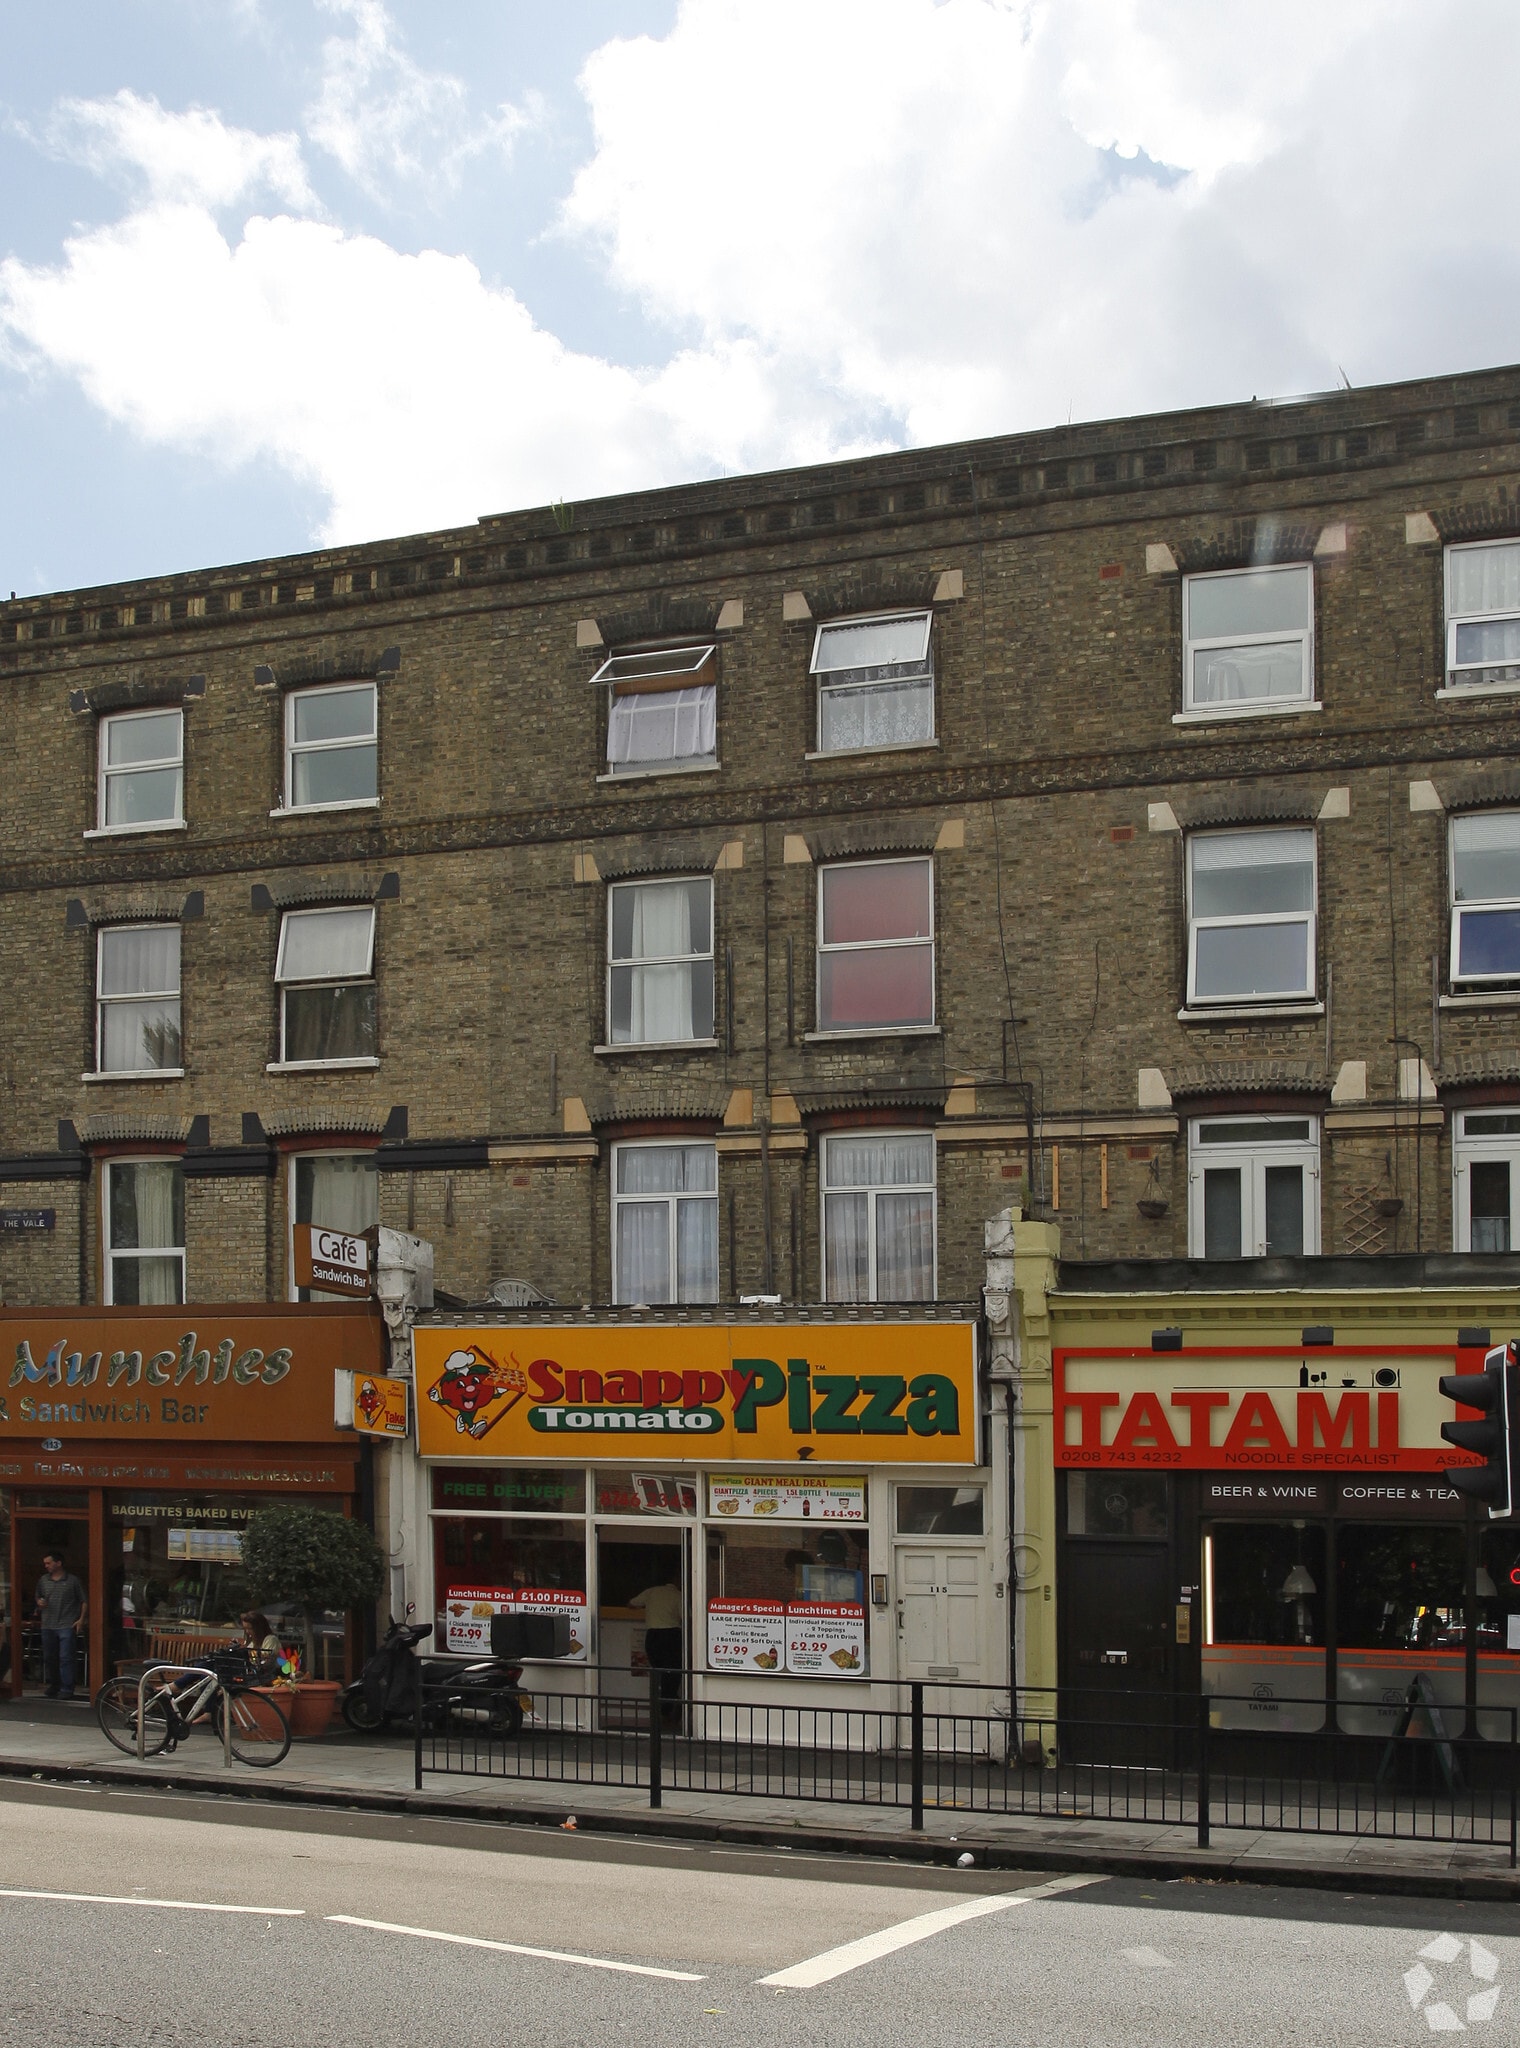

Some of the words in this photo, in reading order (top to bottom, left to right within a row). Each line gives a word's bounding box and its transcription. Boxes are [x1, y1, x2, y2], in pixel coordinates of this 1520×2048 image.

[23, 1219, 45, 1227] VALE
[319, 1233, 357, 1264] Café
[313, 1265, 352, 1285] Sandwich
[353, 1274, 367, 1288] Bar
[8, 1331, 294, 1388] Munchies
[528, 1359, 754, 1411] Snappy
[732, 1359, 961, 1437] Pizza
[20, 1396, 150, 1423] Sandwich
[161, 1398, 208, 1424] Bar
[384, 1410, 405, 1424] Take
[538, 1407, 713, 1429] Tomato
[1064, 1391, 1399, 1447] TATAMI
[1062, 1452, 1101, 1462] 0208
[1107, 1452, 1136, 1462] 743
[1141, 1452, 1182, 1463] 4232
[1225, 1453, 1296, 1464] NOODLE
[1302, 1453, 1400, 1465] SPECIALIST
[1435, 1455, 1487, 1466] ASIAN
[744, 1477, 774, 1487] GIANT
[776, 1478, 801, 1487] MEAL
[803, 1479, 828, 1488] DEAL
[443, 1483, 487, 1497] FREE
[493, 1483, 577, 1499] DELIVERY
[798, 1489, 821, 1497] BOTTLE
[1212, 1486, 1252, 1497] BEER
[1258, 1486, 1268, 1497] &
[1272, 1486, 1317, 1498] WINE
[1342, 1487, 1406, 1499] COFFEE
[1411, 1488, 1421, 1499] &
[1426, 1488, 1460, 1500] TEA
[112, 1505, 182, 1517] BAGUETTES
[186, 1507, 227, 1519] BAKED
[823, 1510, 862, 1519] £14.99
[448, 1589, 492, 1599] Lunchtime
[494, 1590, 514, 1600] Deal
[521, 1592, 550, 1602] £1.00
[553, 1594, 581, 1603] Pizza
[710, 1603, 751, 1612] Manager's
[753, 1605, 783, 1613] Special
[788, 1606, 838, 1615] Lunchtime
[840, 1608, 863, 1616] Deal
[450, 1626, 482, 1639] £2.99
[713, 1645, 748, 1656] £7.99
[791, 1642, 828, 1652] £2.29
[1248, 1703, 1279, 1711] TATAMI
